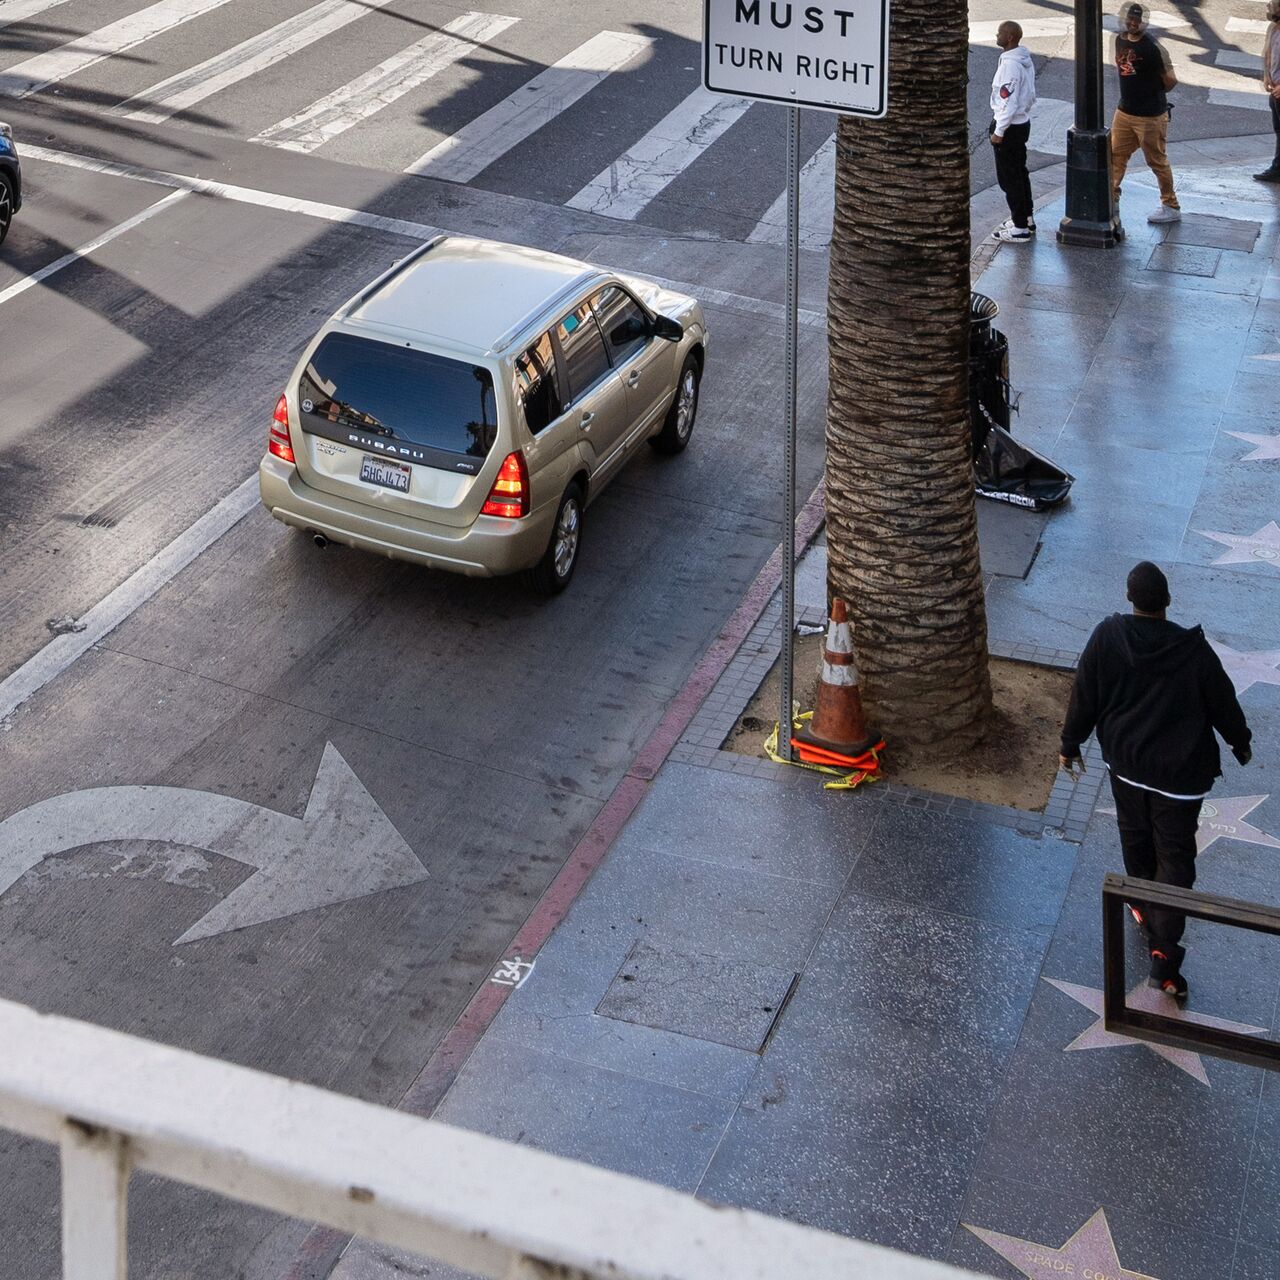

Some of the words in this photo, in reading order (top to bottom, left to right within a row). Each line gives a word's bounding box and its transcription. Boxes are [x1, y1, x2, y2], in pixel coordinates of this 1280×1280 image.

[715, 43, 782, 73] TURN
[796, 54, 875, 85] RIGHT
[348, 434, 424, 459] SUBARU
[362, 464, 408, 489] 5HGJ473
[1025, 1252, 1074, 1274] SPADE
